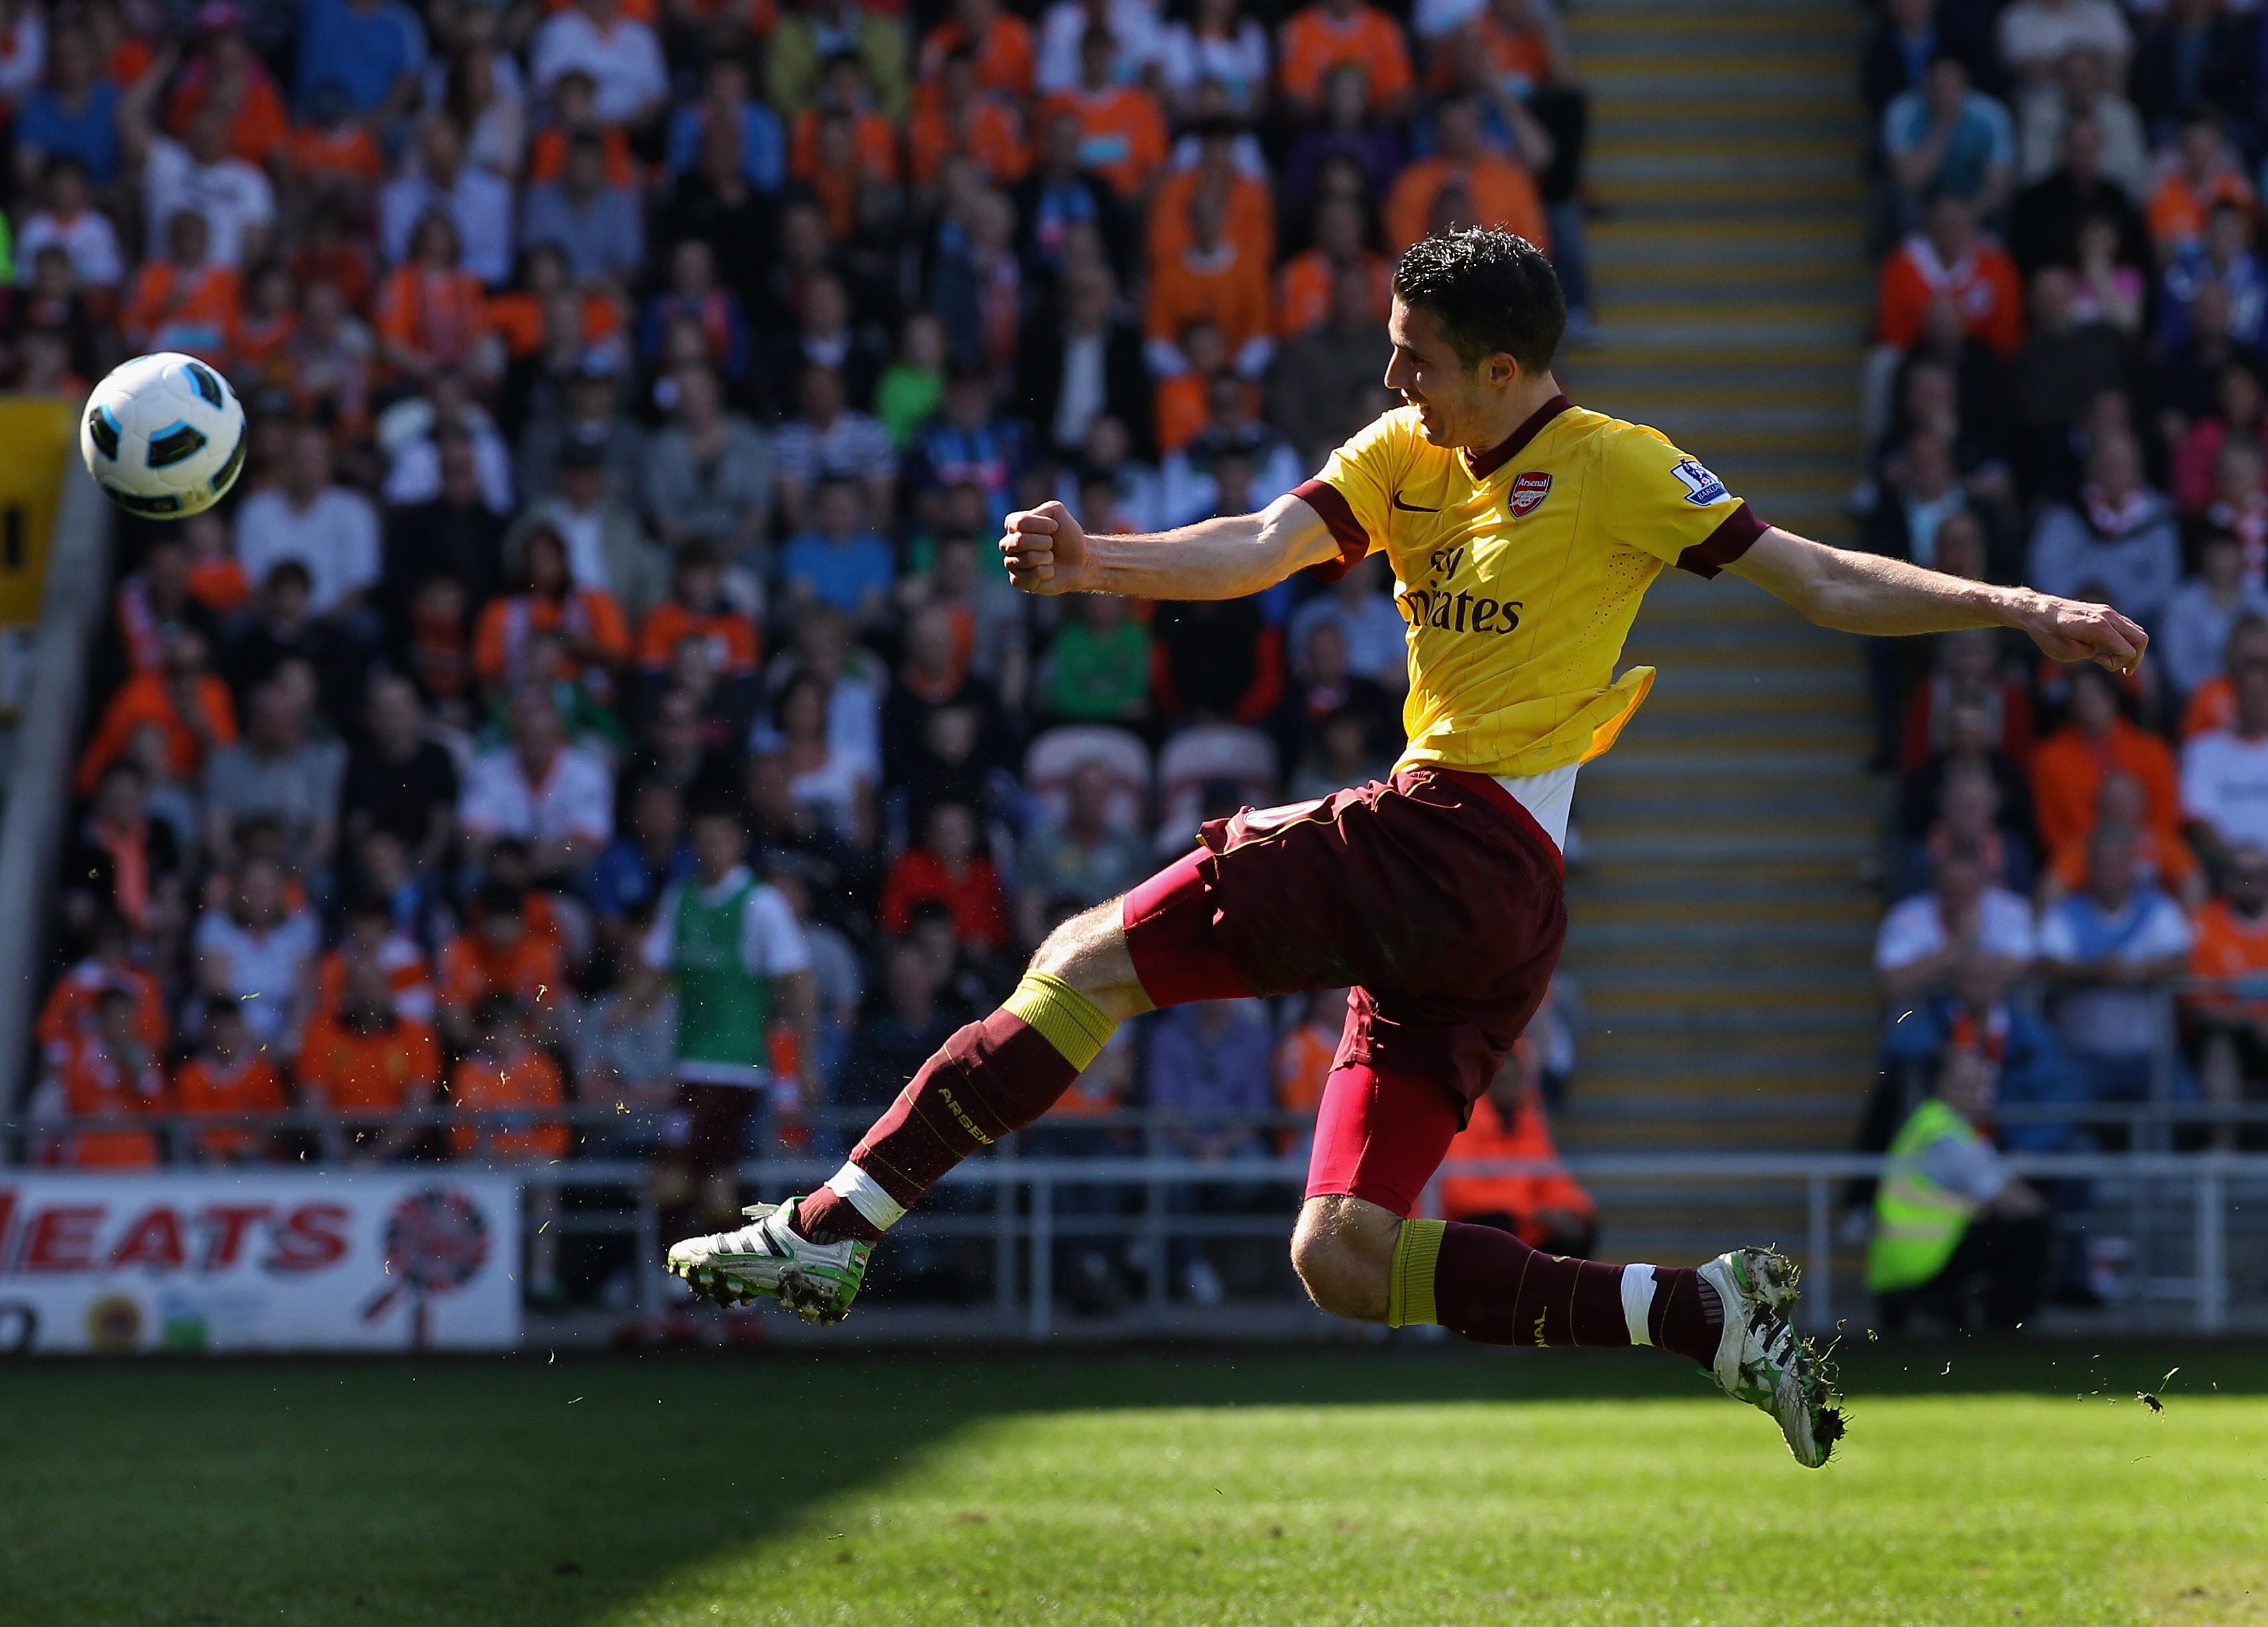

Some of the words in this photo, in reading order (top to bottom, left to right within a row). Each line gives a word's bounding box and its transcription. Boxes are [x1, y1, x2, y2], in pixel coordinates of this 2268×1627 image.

[1518, 478, 1547, 487] Arsenal
[1395, 579, 1523, 634] mirates
[0, 1185, 351, 1276] EATS
